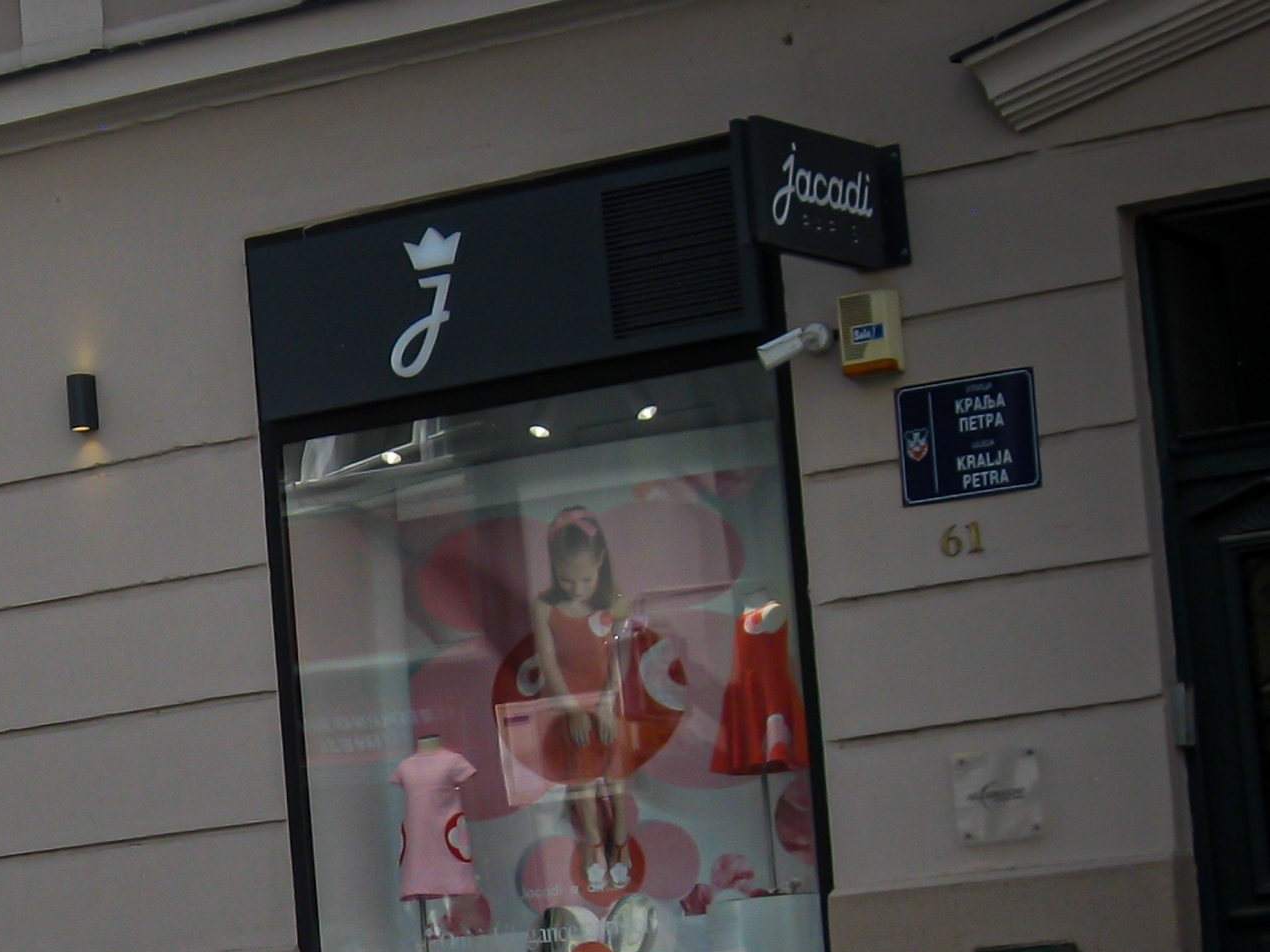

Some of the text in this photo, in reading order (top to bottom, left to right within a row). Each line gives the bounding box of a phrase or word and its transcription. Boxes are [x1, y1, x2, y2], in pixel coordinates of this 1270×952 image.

[772, 141, 874, 227] jacadi
[954, 392, 1006, 415] КРАЉА
[959, 411, 1005, 432] ПЕТРА
[956, 448, 1013, 471] KRALJA
[962, 468, 1010, 490] PETRA
[941, 521, 984, 557] 61
